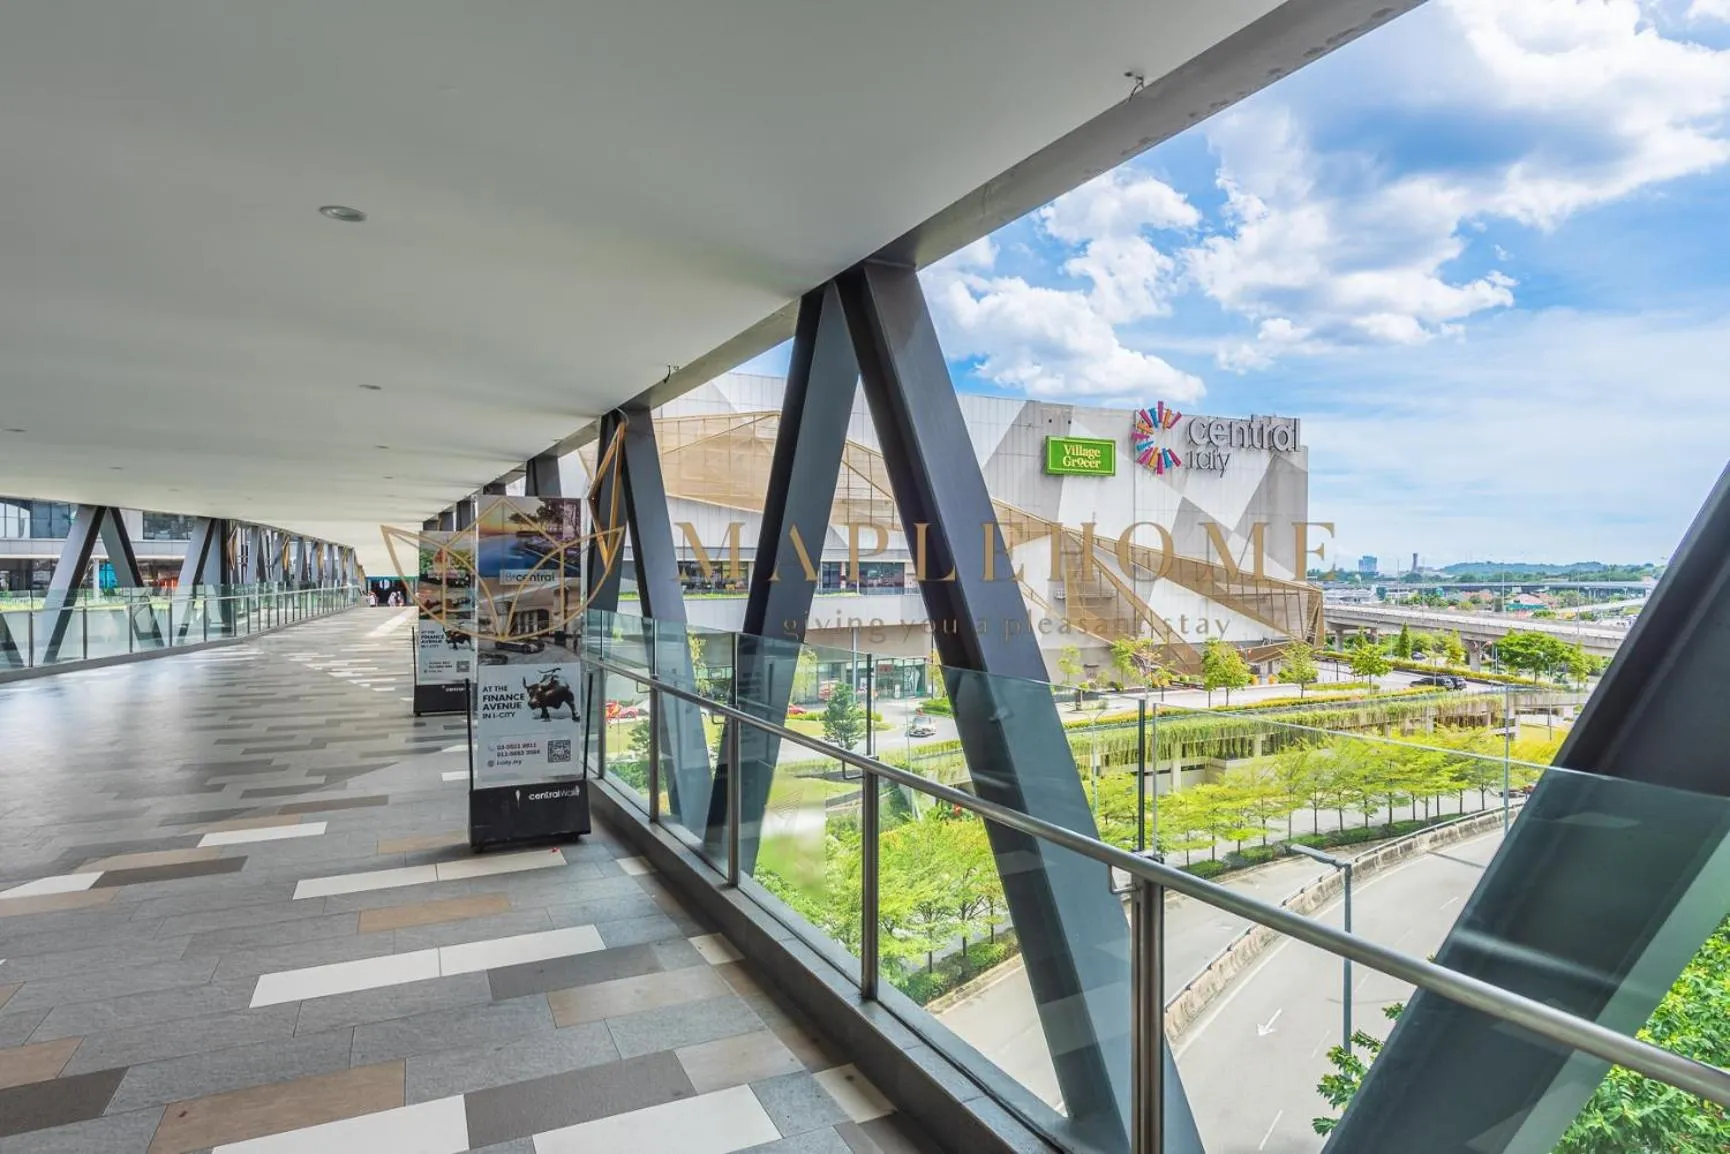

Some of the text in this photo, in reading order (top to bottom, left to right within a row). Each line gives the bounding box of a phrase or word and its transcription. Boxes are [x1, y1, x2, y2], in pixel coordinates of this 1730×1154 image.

[1188, 414, 1301, 453] central
[1063, 444, 1101, 458] Village
[1062, 455, 1101, 469] Grocer
[482, 693, 526, 702] FINANCE
[482, 702, 523, 711] AVENUE
